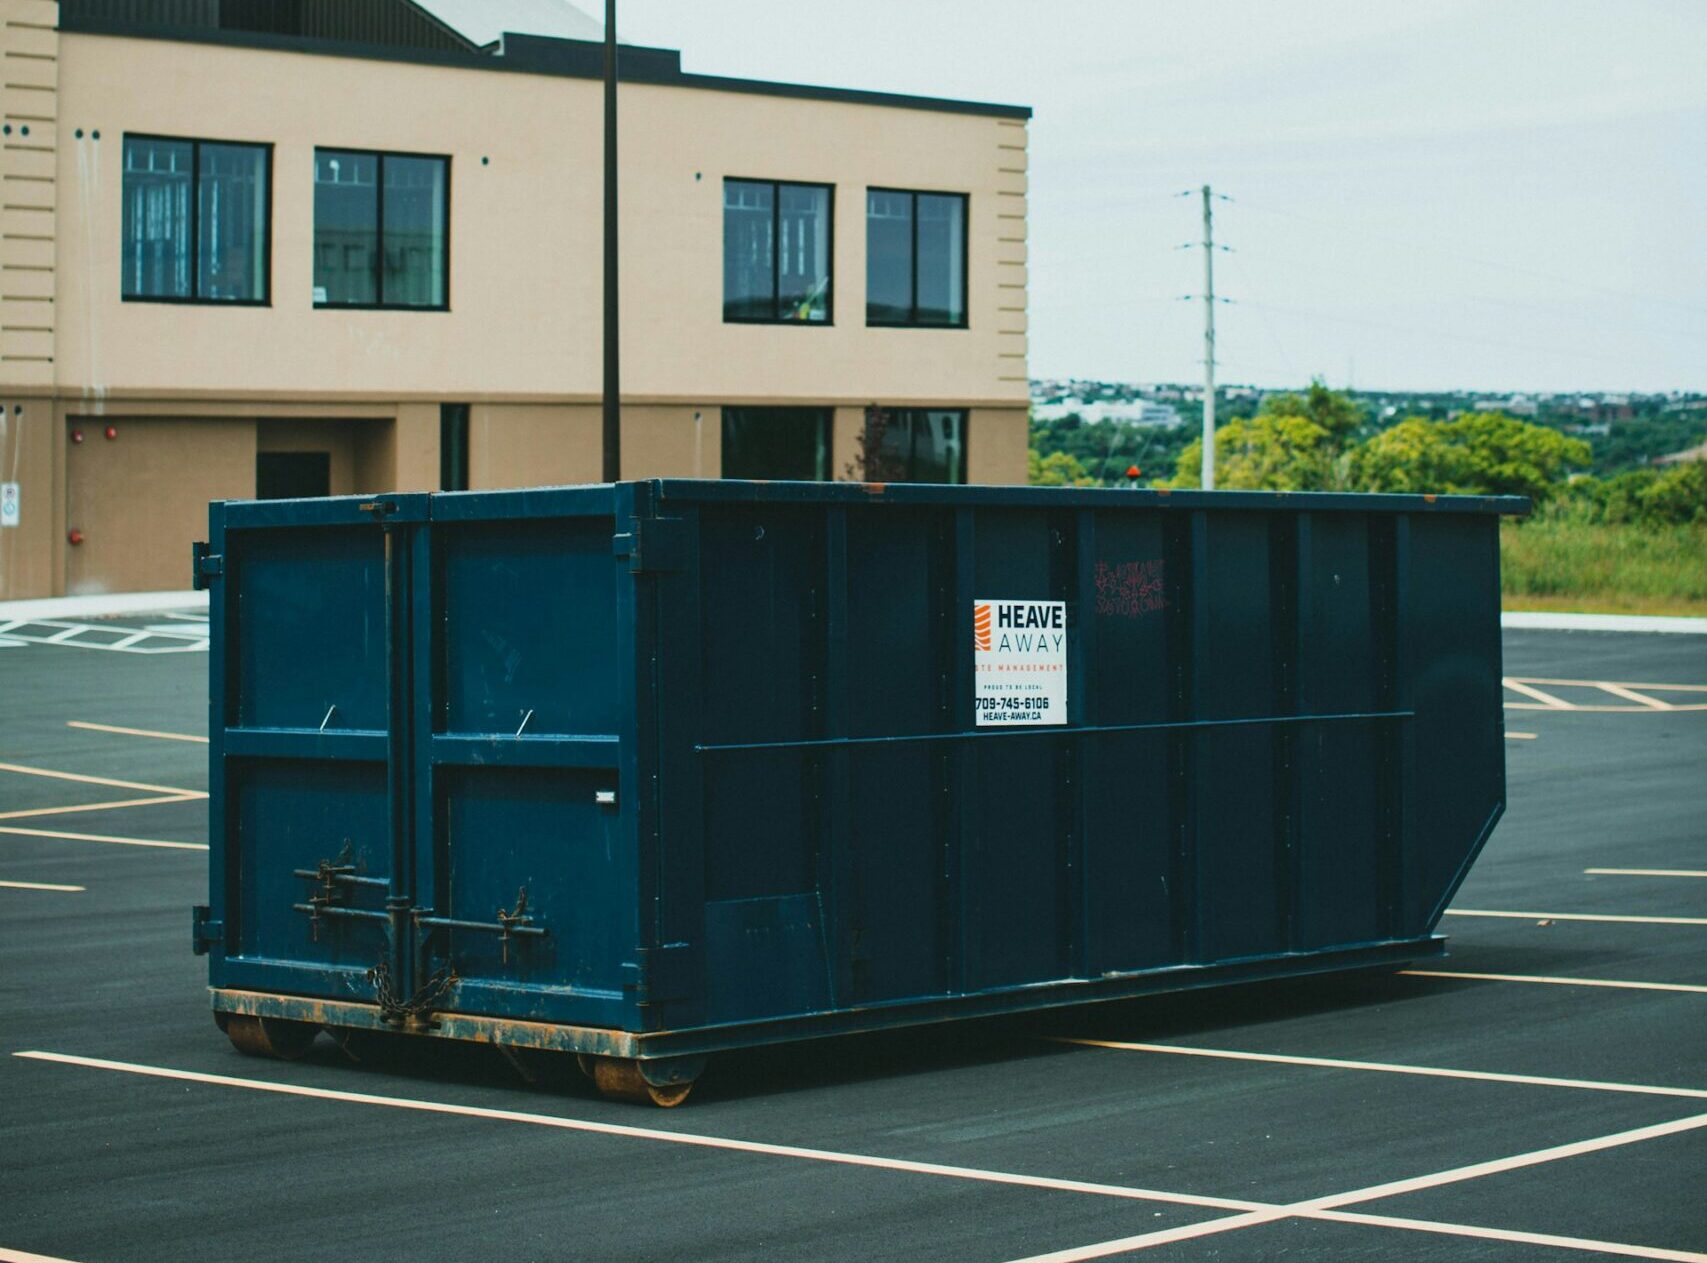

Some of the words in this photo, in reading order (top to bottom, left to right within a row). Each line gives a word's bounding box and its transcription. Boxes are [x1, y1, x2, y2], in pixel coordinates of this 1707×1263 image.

[998, 605, 1063, 629] HEAVE
[998, 633, 1063, 653] AWAY
[998, 664, 1063, 672] MANAGEMENT
[975, 697, 1049, 710] 709-745-6106
[983, 711, 1042, 721] HEAVE-AWAY.CA
